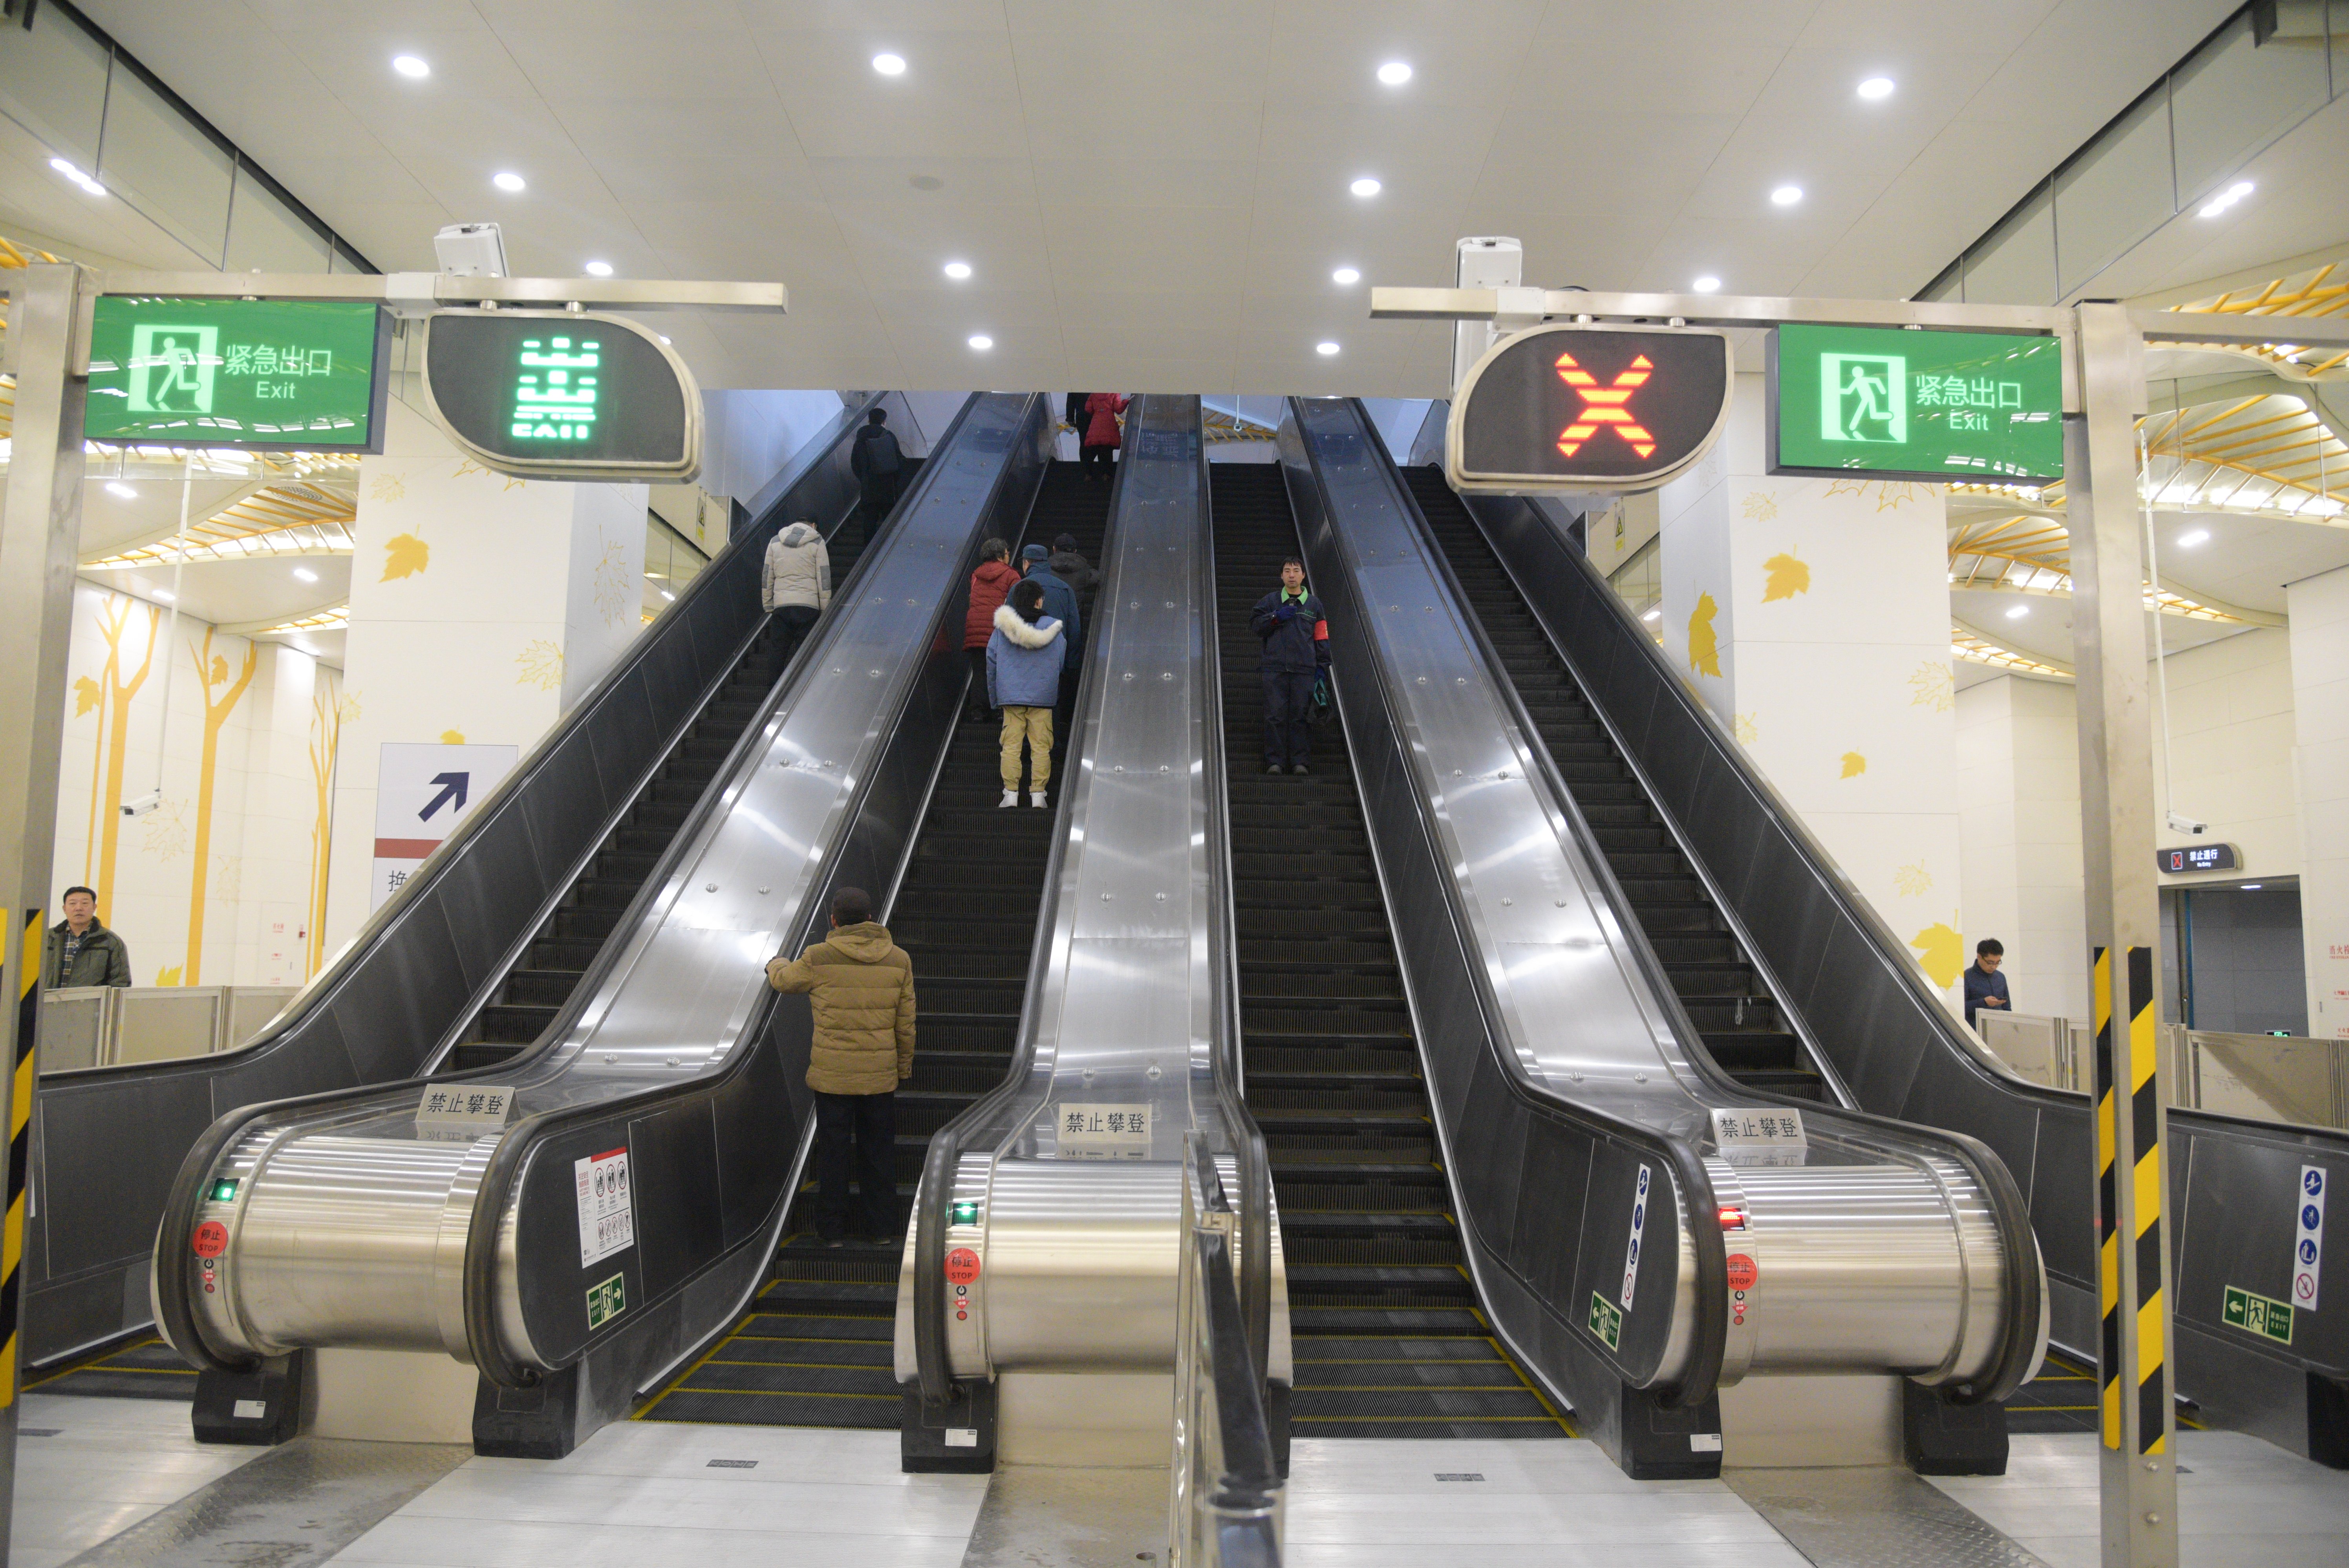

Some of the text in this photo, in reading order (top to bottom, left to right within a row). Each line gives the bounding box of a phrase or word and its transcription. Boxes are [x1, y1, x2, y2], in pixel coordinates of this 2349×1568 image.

[225, 344, 331, 377] 紧急出口
[256, 381, 295, 399] Exit
[1916, 375, 2021, 409] 紧急出口
[1950, 412, 1989, 431] Exit
[2190, 849, 2218, 862] 禁止通行
[426, 1092, 504, 1114] 禁止攀登
[1066, 1112, 1145, 1133] 禁止攀登
[1720, 1117, 1798, 1138] 禁止攀登
[201, 1229, 220, 1240] 停止
[952, 1257, 972, 1267] 停止
[1730, 1262, 1750, 1273] 停止
[2271, 1321, 2286, 1332] EXIT
